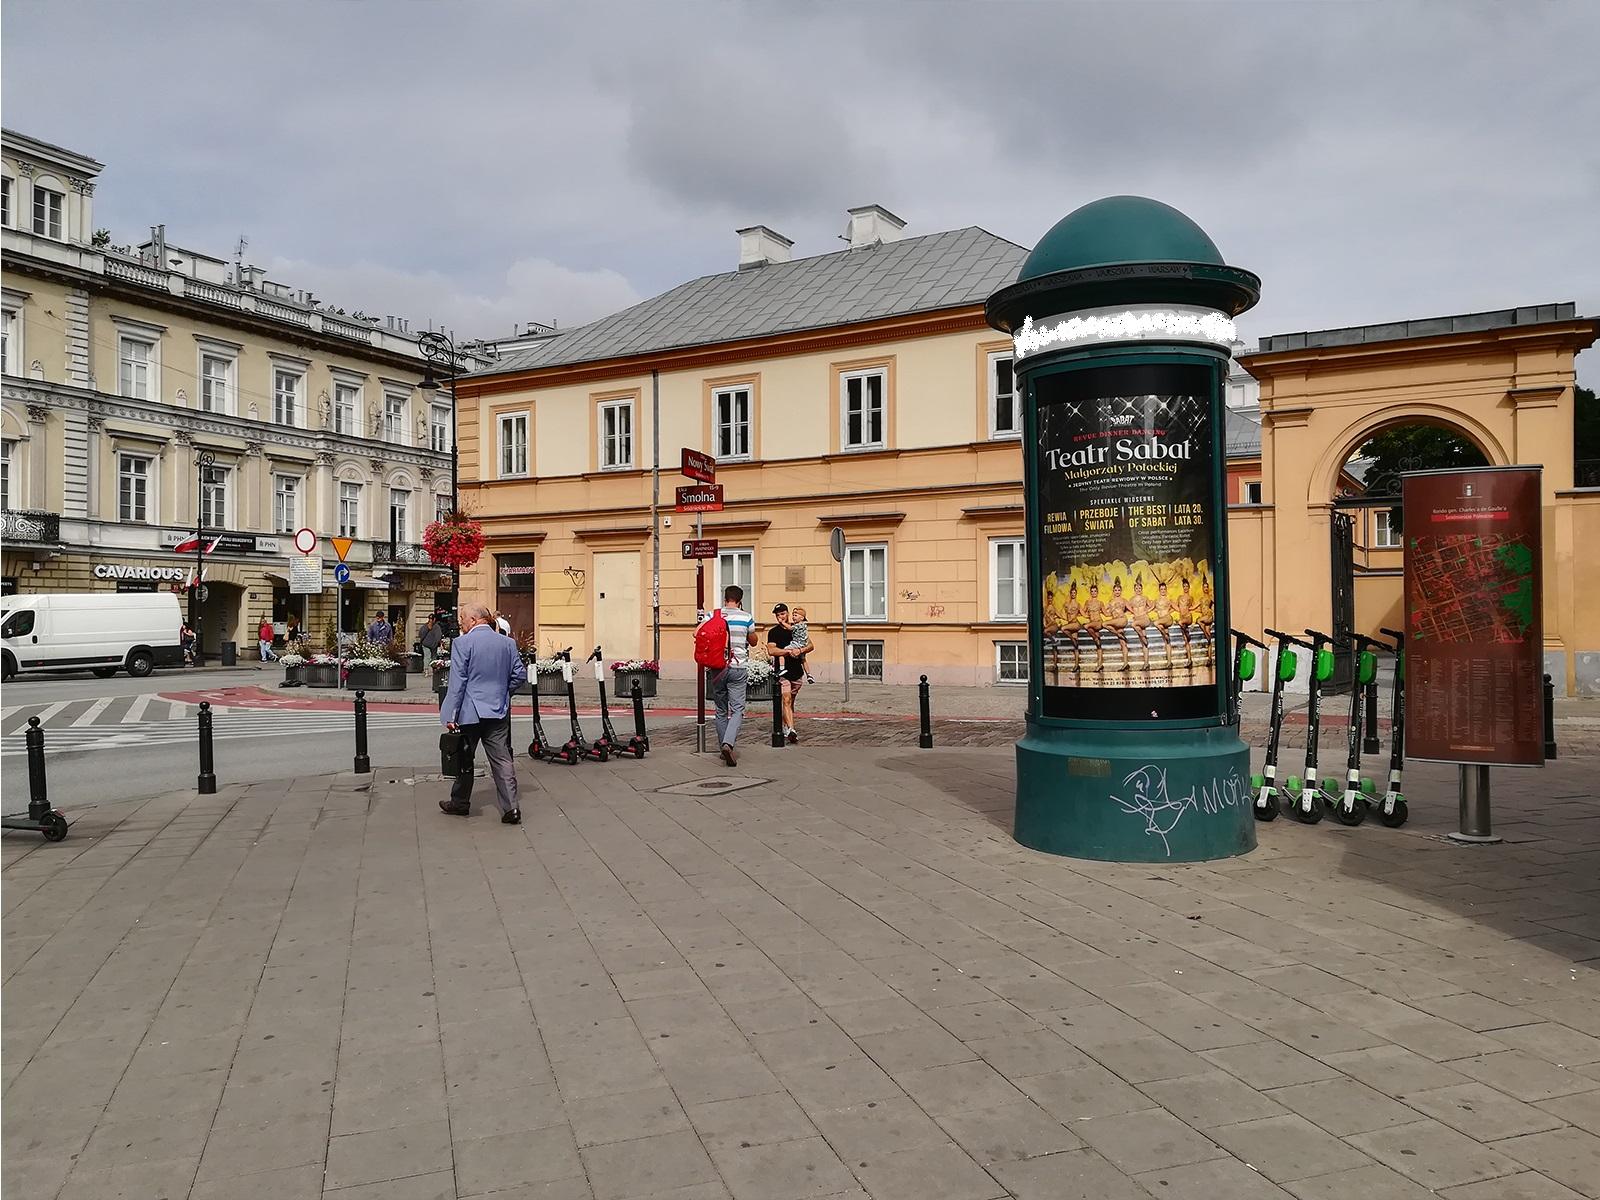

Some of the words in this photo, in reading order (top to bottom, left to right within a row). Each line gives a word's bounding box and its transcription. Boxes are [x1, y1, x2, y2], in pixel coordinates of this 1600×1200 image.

[1099, 430, 1130, 438] DINNER
[1045, 444, 1109, 471] Teatr
[1115, 436, 1192, 461] Sabat
[1127, 461, 1178, 473] Potockiej
[681, 491, 716, 504] Smolna
[1079, 506, 1119, 520] PRZEBOJE
[1127, 505, 1144, 516] THE
[1146, 504, 1167, 515] BEST
[1174, 504, 1191, 514] LATA
[1192, 503, 1203, 513] 20.
[1047, 511, 1067, 523] REWIA
[1128, 518, 1139, 528] OF
[1141, 516, 1167, 527] SABAT
[1174, 515, 1192, 525] LATA
[1193, 515, 1204, 525] 30.
[1043, 522, 1073, 534] FILMOWA
[1084, 518, 1115, 531] ŚWIATA
[264, 540, 276, 548] PHN
[94, 564, 184, 580] CAVARIOUS
